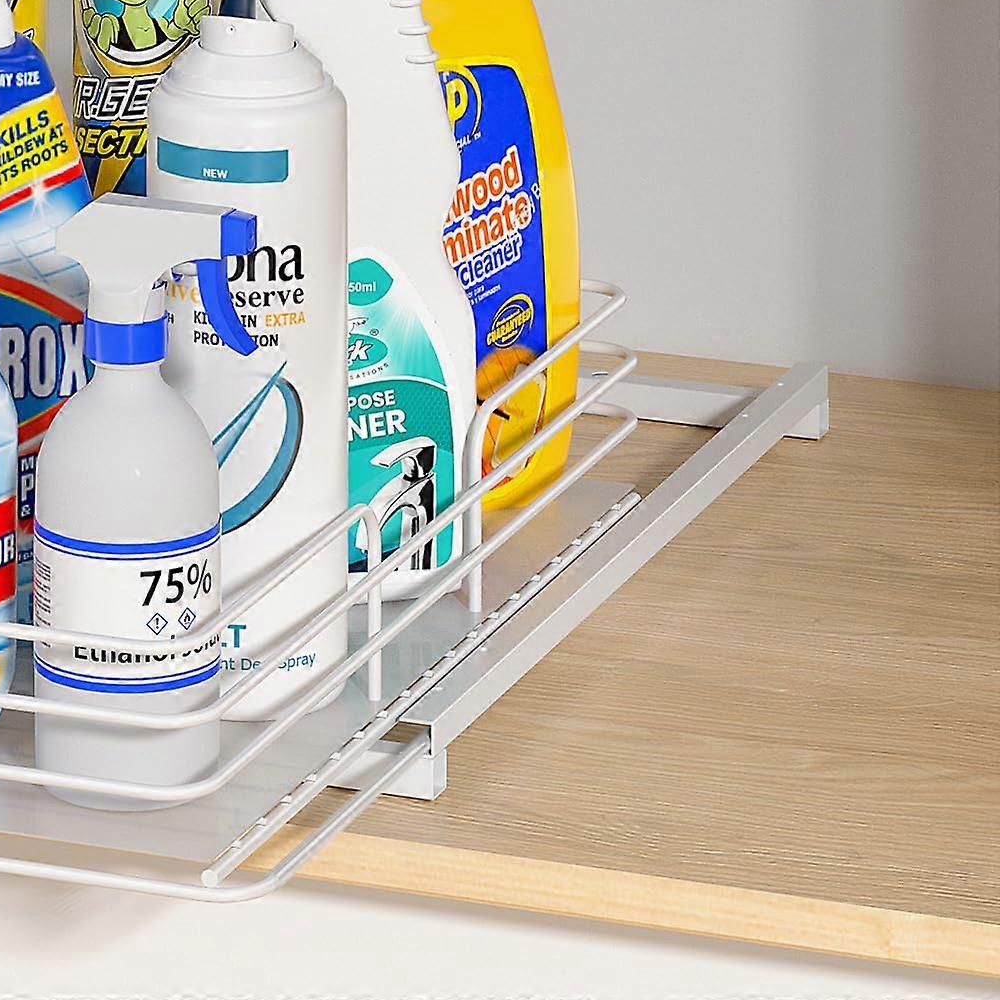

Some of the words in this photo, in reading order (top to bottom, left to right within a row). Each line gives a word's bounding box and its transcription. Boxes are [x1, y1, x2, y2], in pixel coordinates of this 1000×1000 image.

[15, 71, 41, 86] SIZE
[49, 123, 64, 140] AT
[21, 140, 69, 172] ROOTS
[203, 168, 228, 179] NEW
[447, 151, 520, 222] wood
[229, 287, 304, 308] serve
[265, 311, 305, 327] EXTRA
[348, 409, 407, 442] NER
[140, 559, 212, 606] 75%
